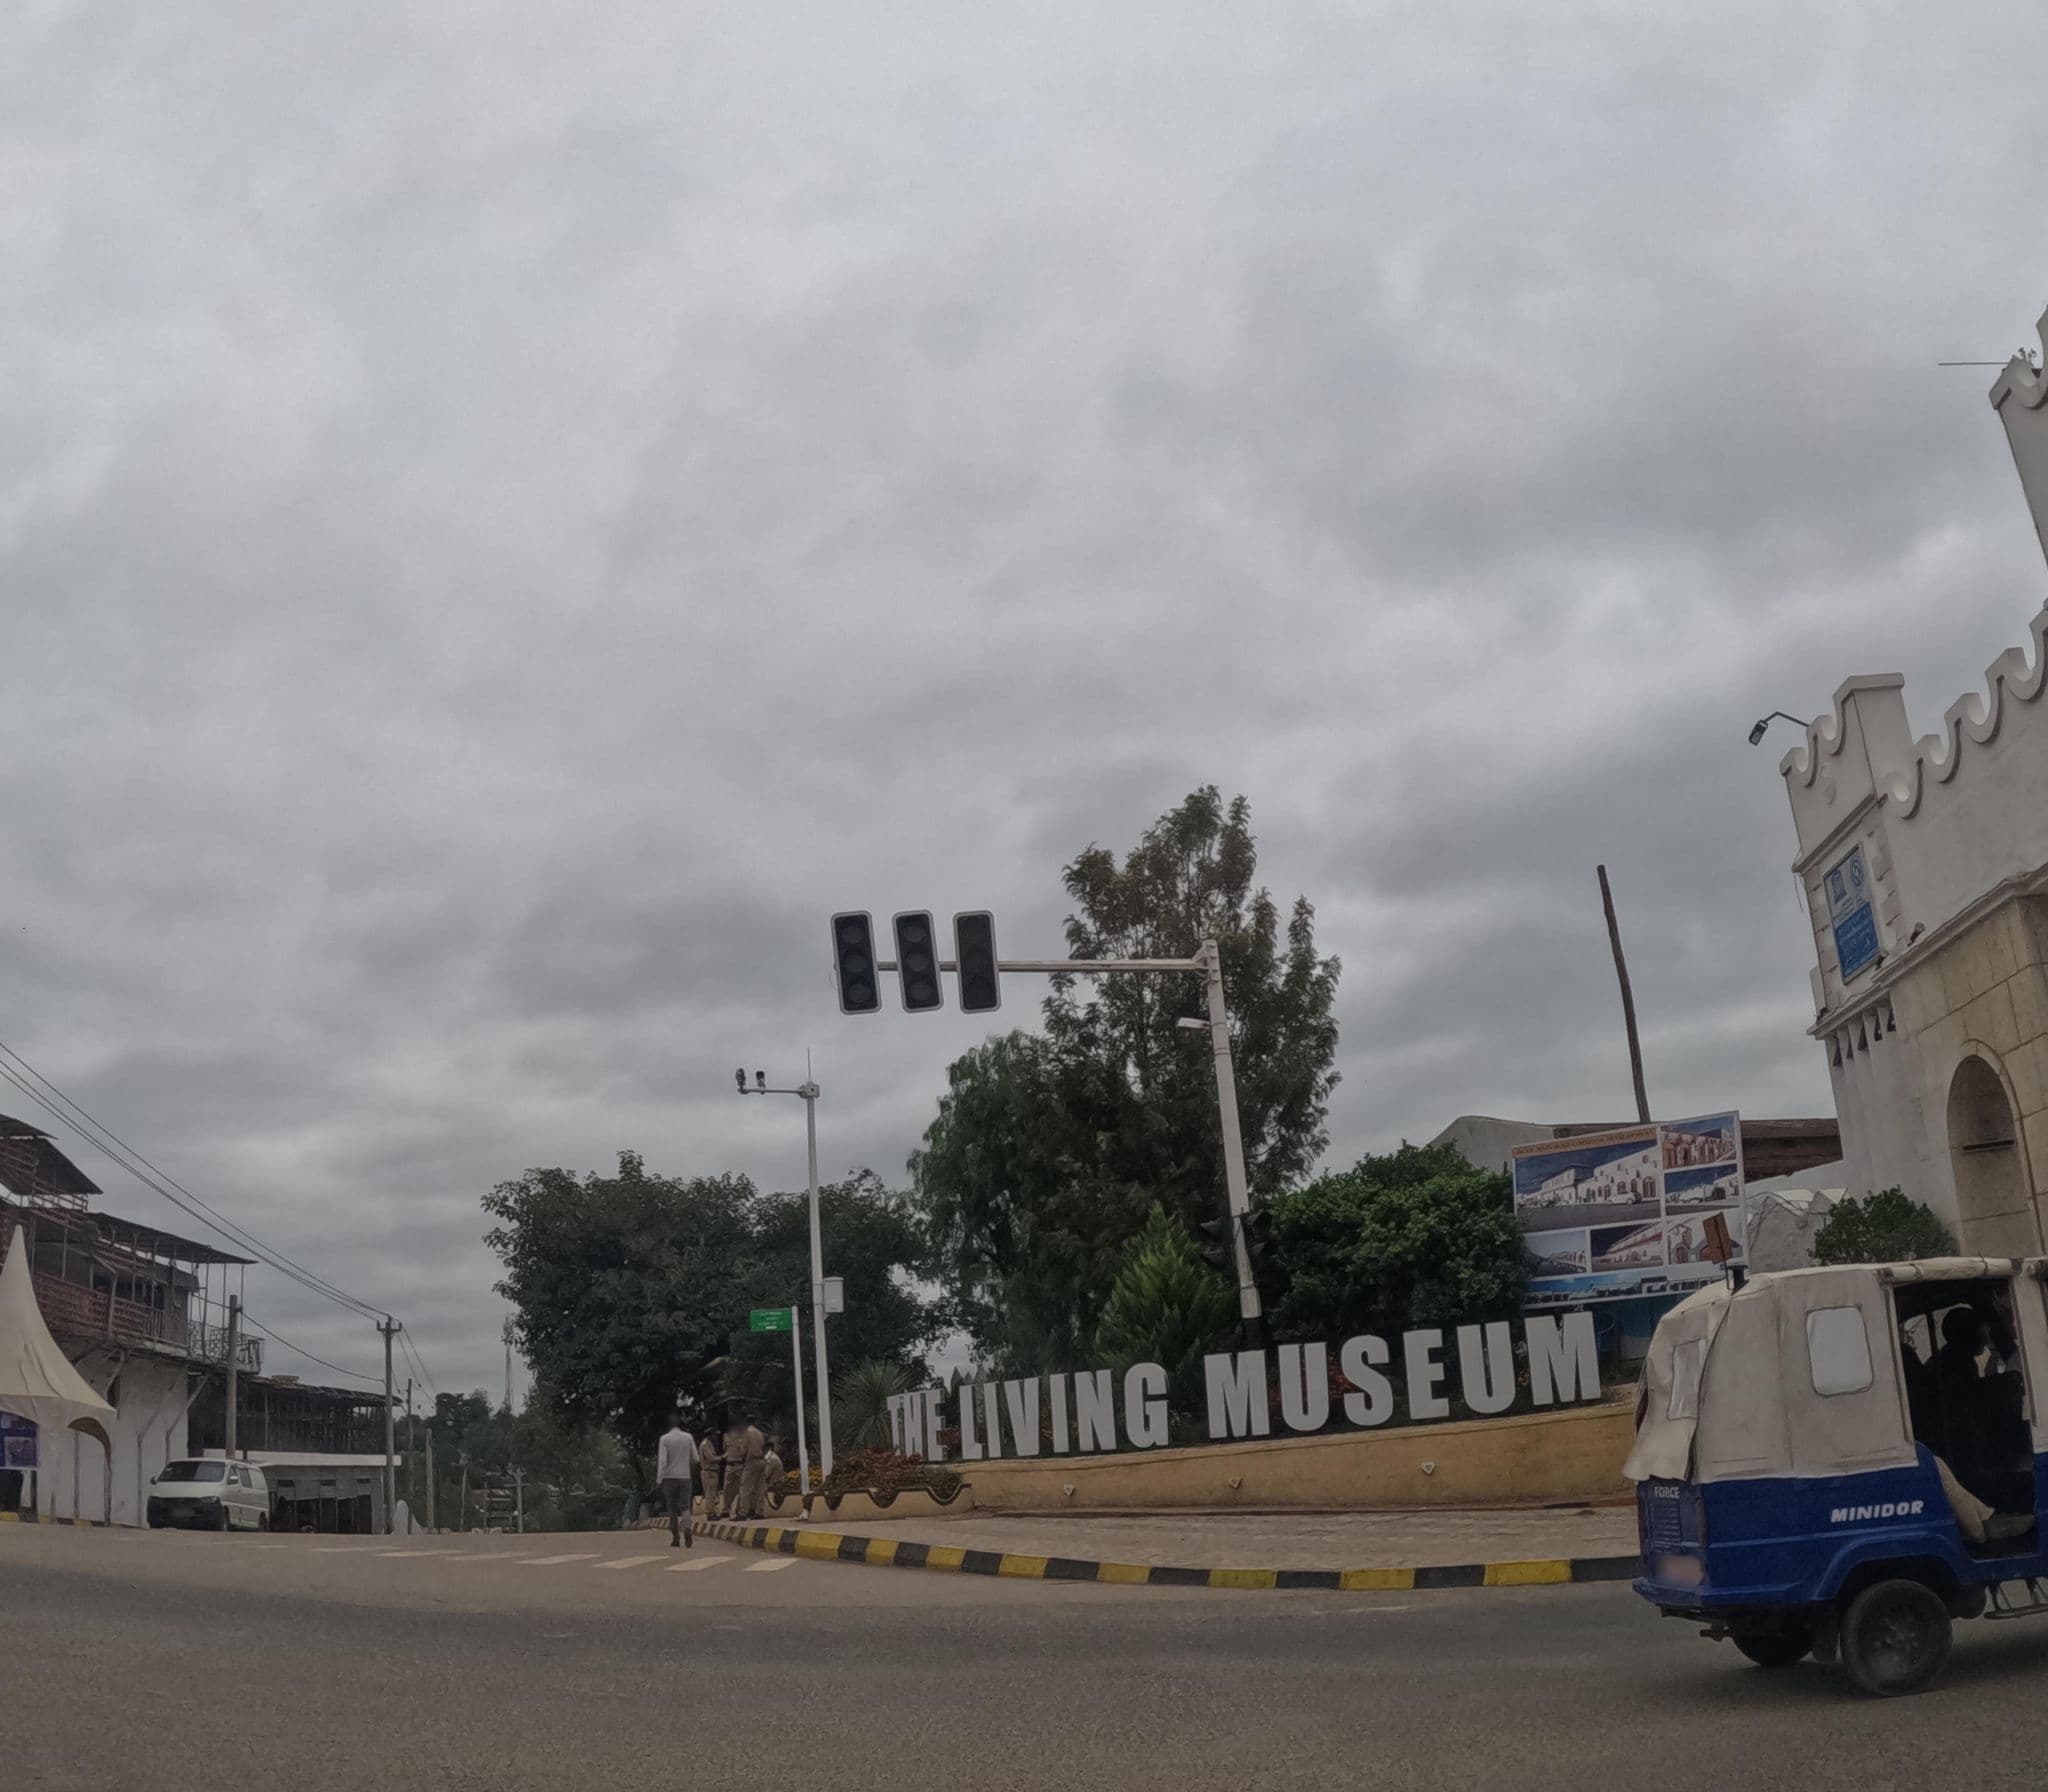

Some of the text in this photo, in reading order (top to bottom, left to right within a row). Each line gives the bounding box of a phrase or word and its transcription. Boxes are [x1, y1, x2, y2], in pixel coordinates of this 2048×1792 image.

[886, 1311, 1601, 1462] THE LIVING MUSEUM
[1654, 1486, 1680, 1499] FORCE
[1830, 1500, 1924, 1523] MINIDOR
